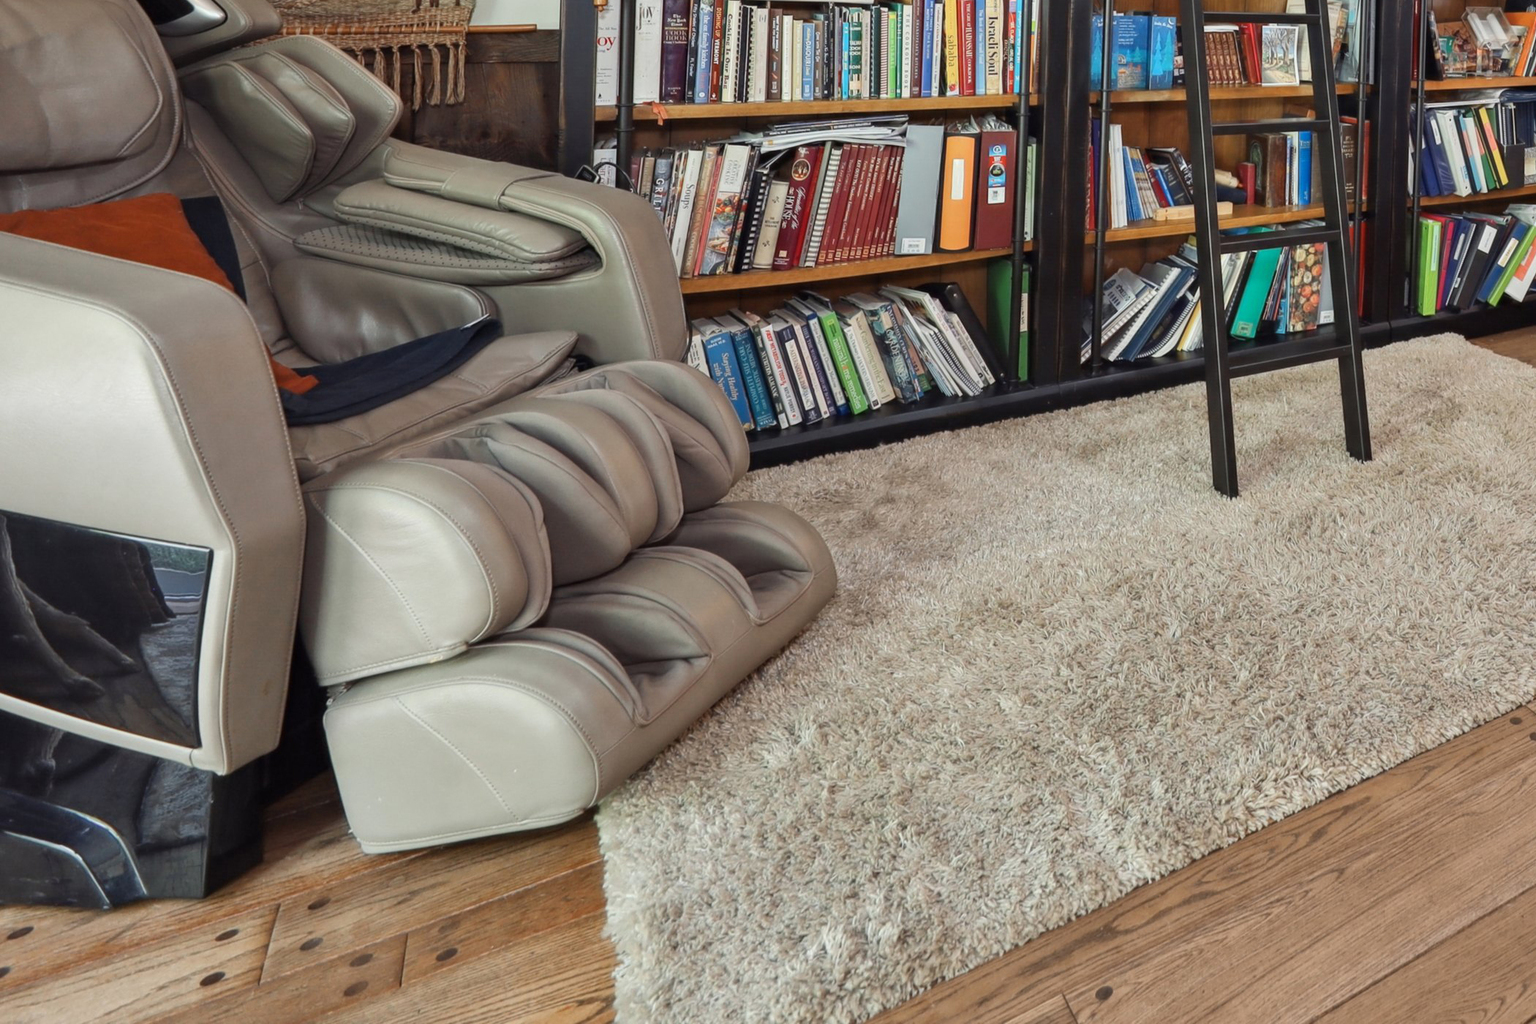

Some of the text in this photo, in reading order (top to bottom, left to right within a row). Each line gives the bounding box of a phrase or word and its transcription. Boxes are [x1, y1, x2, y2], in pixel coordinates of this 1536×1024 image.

[597, 36, 617, 51] oy
[700, 32, 709, 49] family
[725, 14, 733, 46] Cooking
[948, 34, 956, 67] sababa
[988, 16, 999, 76] Israeli Soul
[681, 183, 695, 210] Soups
[782, 195, 793, 220] HOUSE
[713, 362, 722, 377] with
[721, 352, 739, 401] Staying Healthy
[832, 338, 863, 410] natural home remedies
